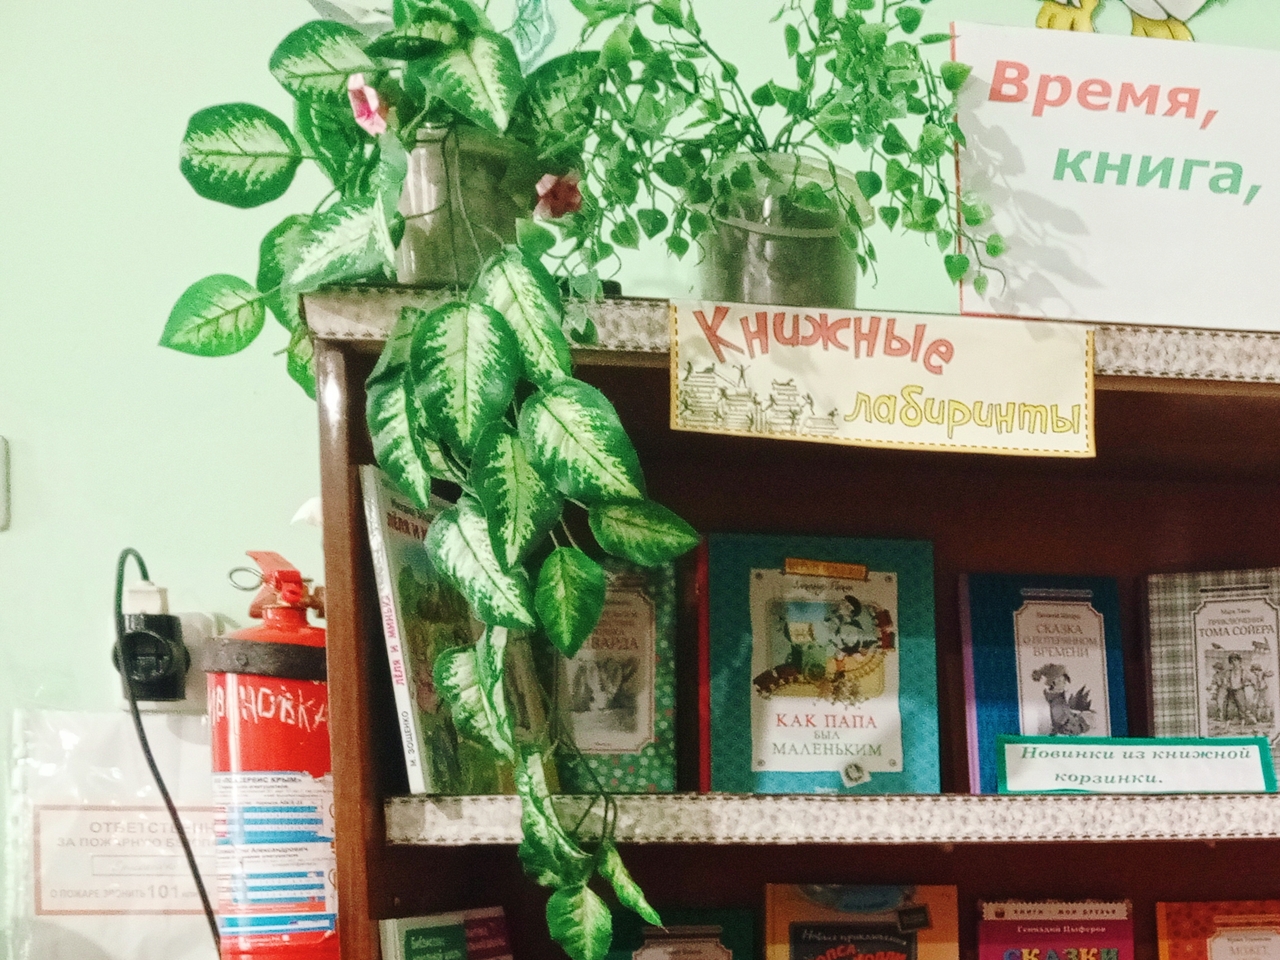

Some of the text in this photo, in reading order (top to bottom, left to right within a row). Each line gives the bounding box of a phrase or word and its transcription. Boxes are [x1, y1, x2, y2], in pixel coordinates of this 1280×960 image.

[988, 60, 1219, 130] Время,
[1051, 145, 1264, 206] книга,
[843, 384, 1084, 439] лабиринты
[776, 713, 878, 729] КАК ПАПА
[813, 730, 841, 740] БЫЛ
[772, 742, 883, 757] МАЛЕНЬКИМ
[1021, 746, 1252, 760] Новинки из книжной
[1054, 771, 1163, 785] корзинки.
